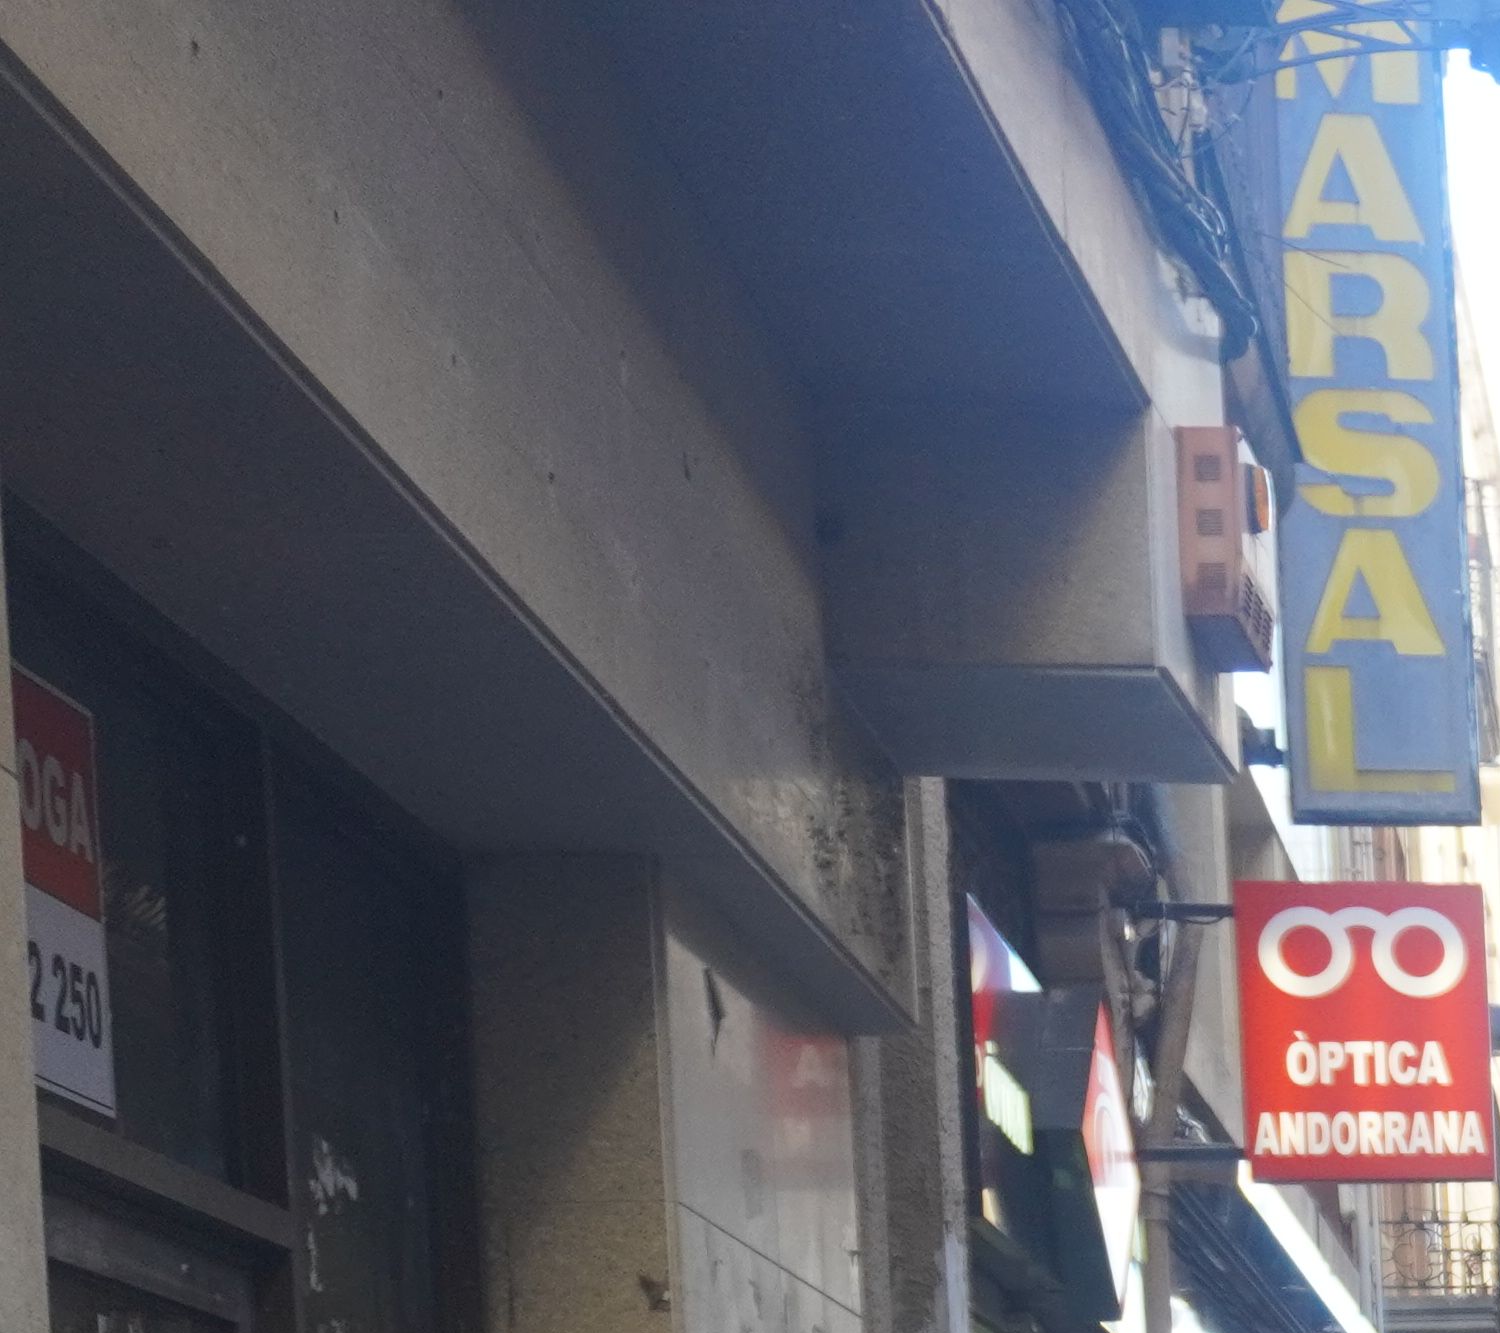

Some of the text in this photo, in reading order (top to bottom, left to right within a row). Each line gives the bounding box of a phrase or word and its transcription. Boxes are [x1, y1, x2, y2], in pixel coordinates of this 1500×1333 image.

[1275, 0, 1455, 794] MARSAL
[52, 953, 103, 1050] 250
[1285, 1029, 1452, 1087] ÒPTICA
[1254, 1110, 1486, 1156] ANDORRANA
